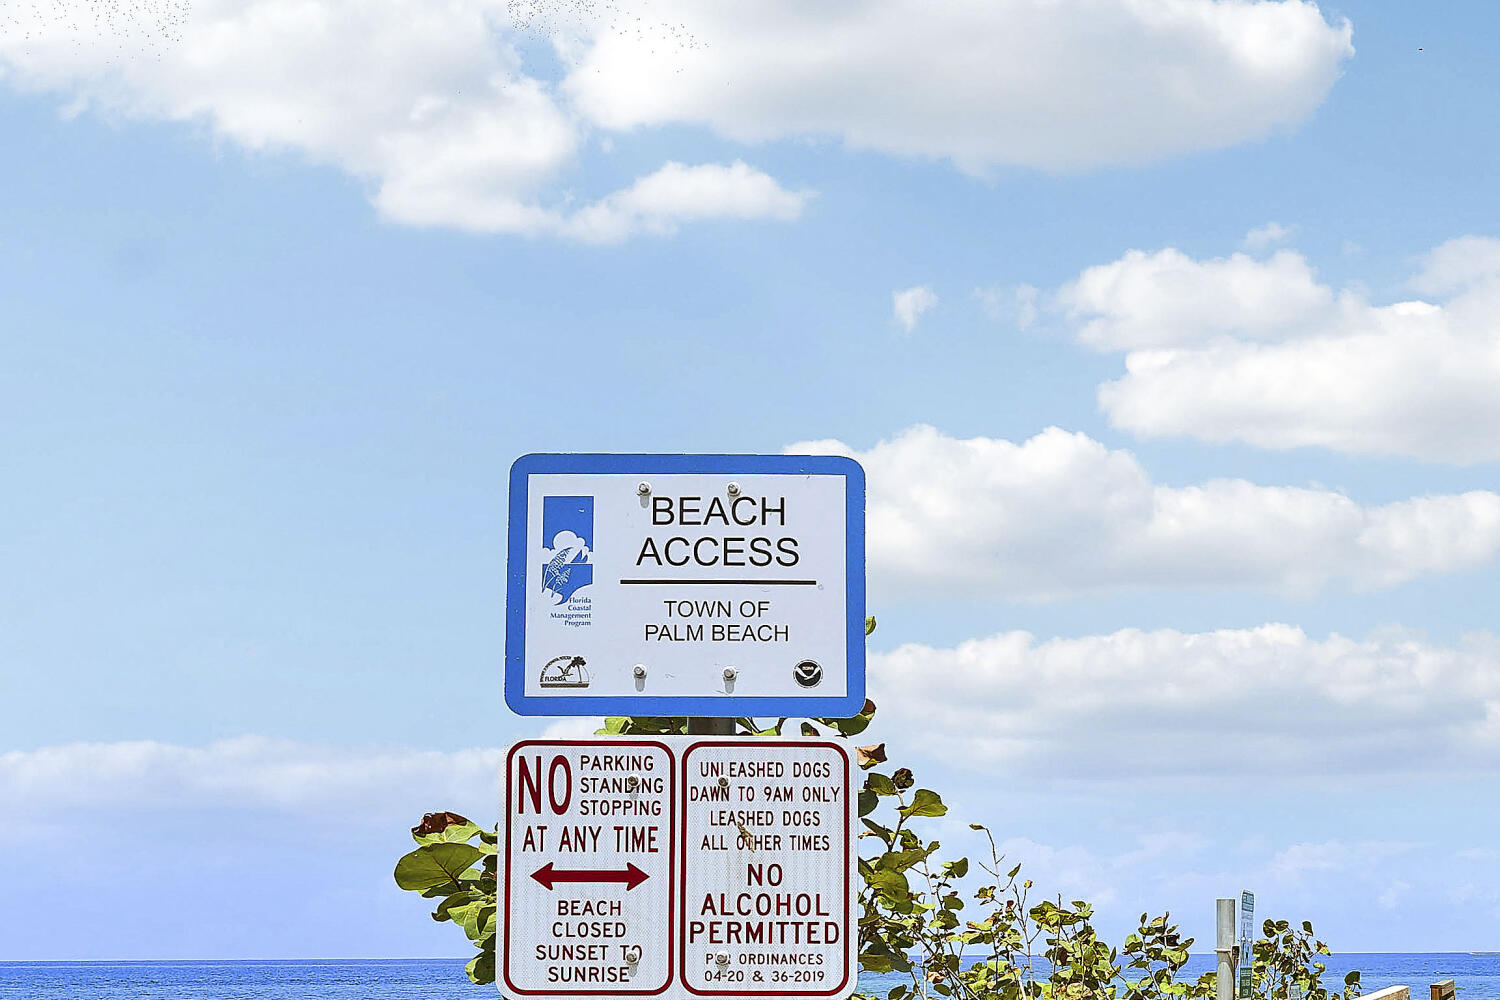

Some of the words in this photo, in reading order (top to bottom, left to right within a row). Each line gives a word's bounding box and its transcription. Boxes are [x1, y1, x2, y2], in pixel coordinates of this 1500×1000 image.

[652, 496, 785, 526] BEACH
[636, 537, 799, 566] ACCESS
[550, 612, 592, 620] Management
[664, 600, 732, 618] TOWN
[739, 600, 770, 618] OF
[564, 620, 592, 628] Program
[645, 624, 704, 642] PALM
[712, 624, 789, 642] BEACH
[580, 755, 654, 771] PARKING
[793, 762, 831, 778] DOGS
[518, 754, 572, 815] NO
[690, 786, 730, 802] DAWN
[738, 786, 755, 802] TO
[763, 786, 793, 802] 9AM
[802, 786, 841, 802] ONLY
[580, 800, 662, 816] STOPPING
[710, 810, 774, 826] LEASHED
[782, 810, 821, 827] DOGS
[522, 825, 547, 852] AT
[559, 825, 602, 853] ANY
[613, 825, 659, 853] TIME
[701, 834, 728, 850] ALL
[789, 834, 830, 851] TIMES
[747, 863, 783, 887] NO
[558, 900, 622, 916] BEACH
[701, 893, 829, 916] ALCOHOL
[552, 922, 626, 938] CLOSED
[689, 921, 840, 944] PERMITTED
[536, 945, 609, 961] SUNSET
[619, 944, 643, 961] TO
[739, 953, 824, 965] ORDINANCES
[548, 966, 630, 982] SUNRISE
[704, 970, 744, 982] 04-20
[752, 970, 765, 982] &
[771, 970, 825, 982] 36-2019
